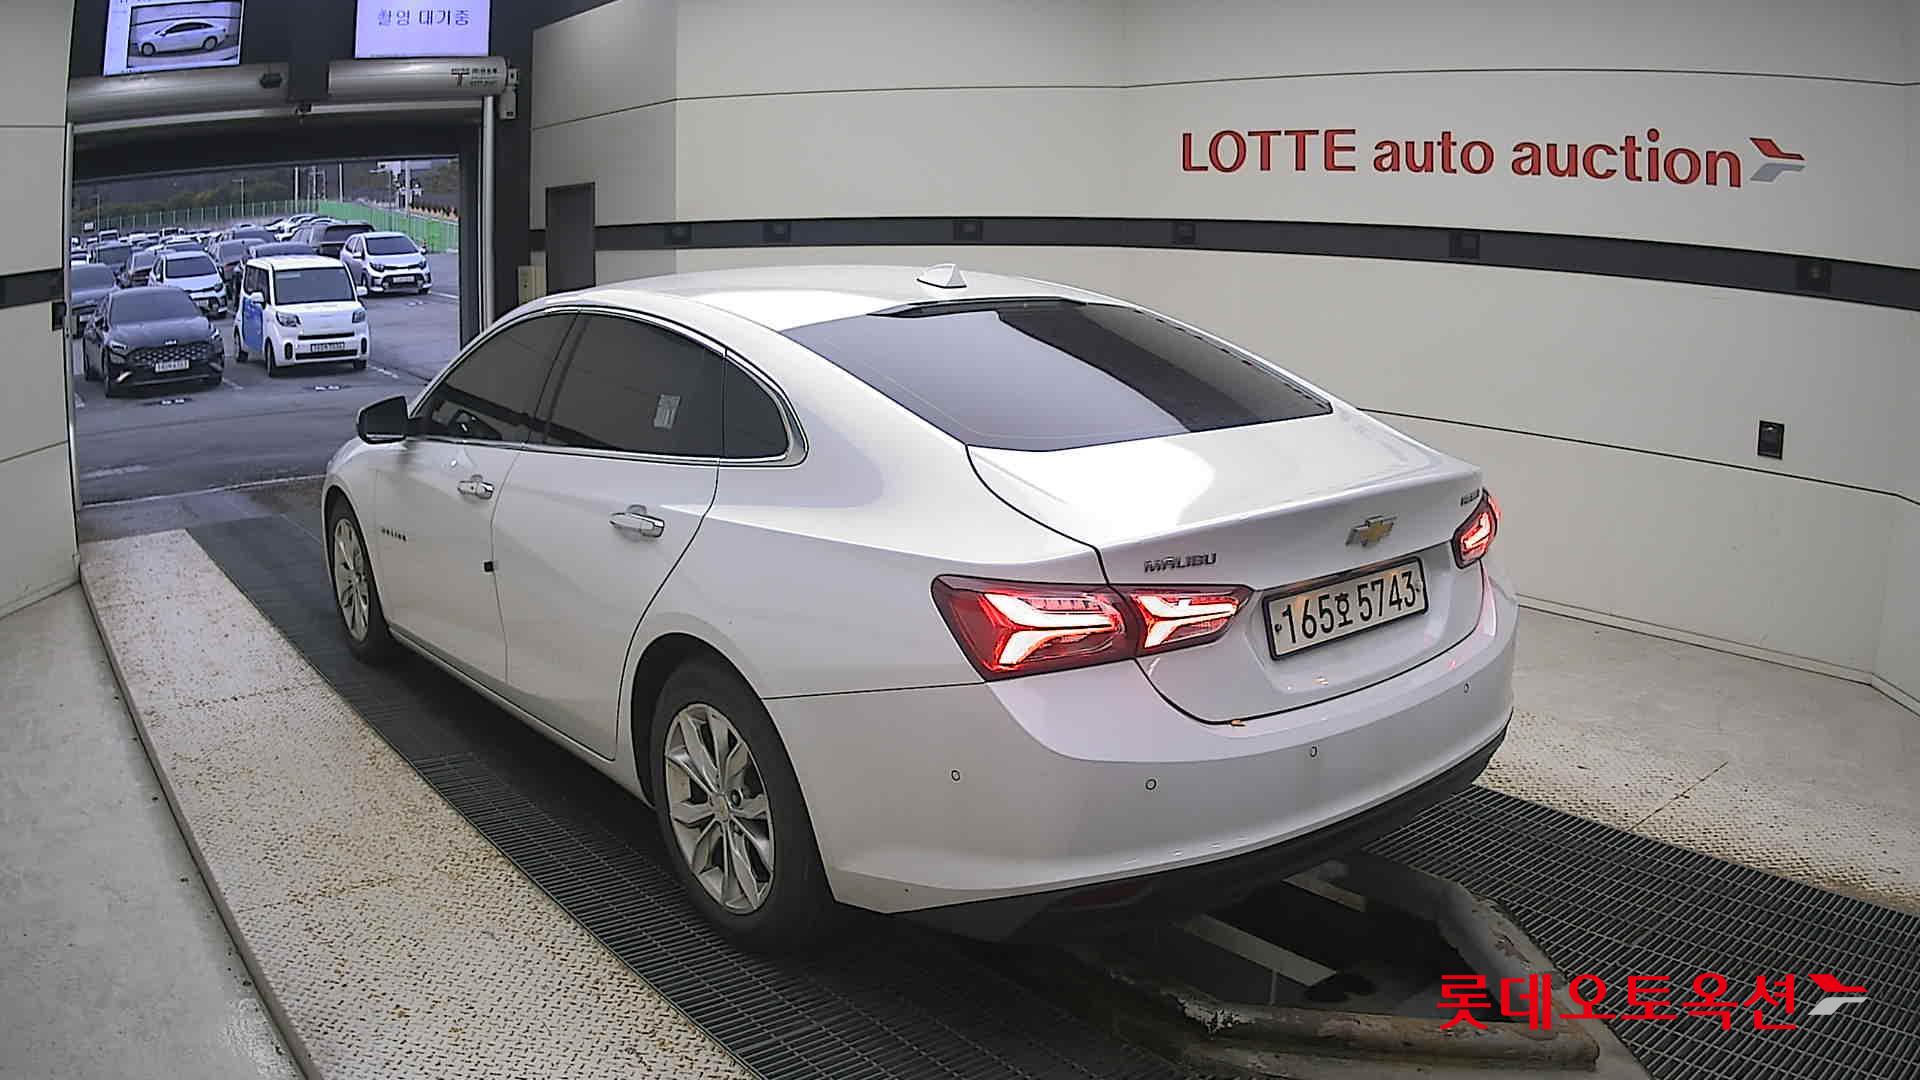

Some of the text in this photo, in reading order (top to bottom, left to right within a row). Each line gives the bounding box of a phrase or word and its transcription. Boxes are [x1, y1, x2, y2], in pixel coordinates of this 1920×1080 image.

[1184, 128, 1742, 188] LOTTE auto auction
[1143, 552, 1217, 573] MALIBU
[1357, 571, 1416, 623] 5743
